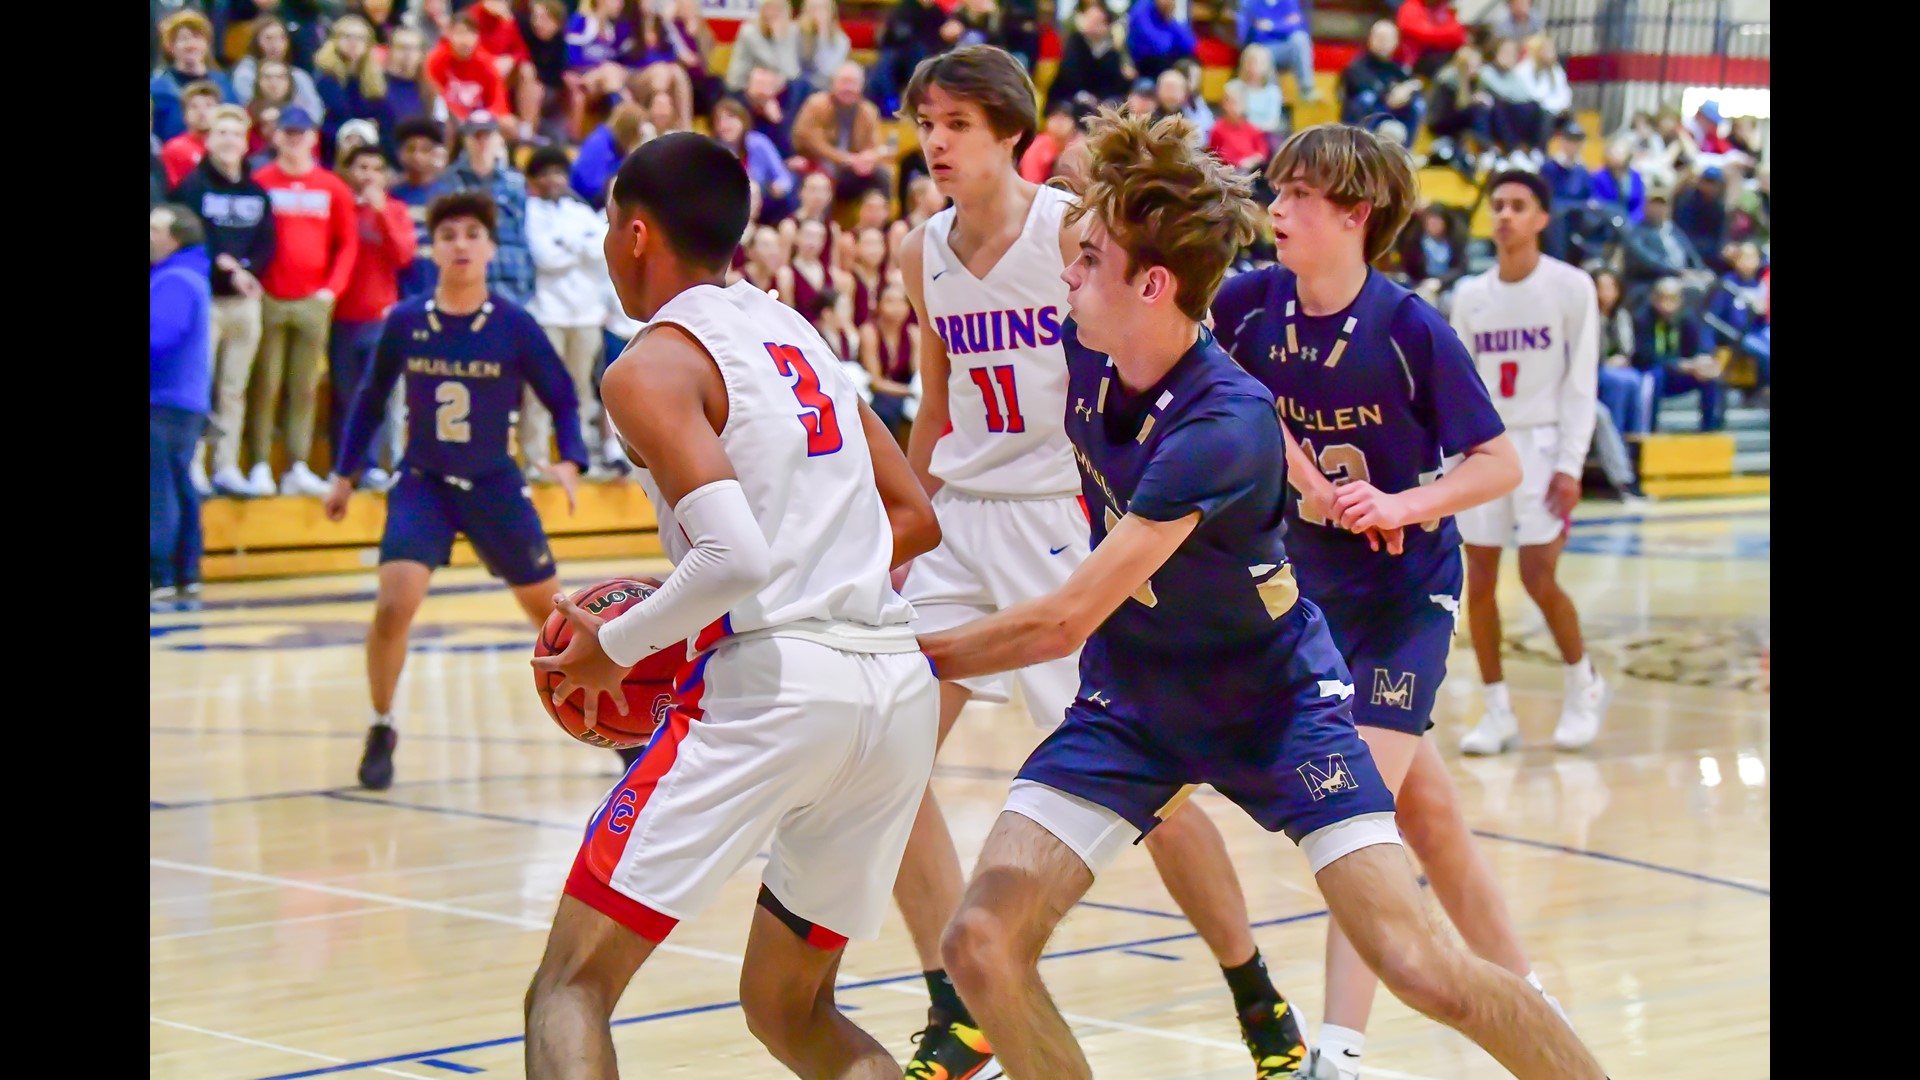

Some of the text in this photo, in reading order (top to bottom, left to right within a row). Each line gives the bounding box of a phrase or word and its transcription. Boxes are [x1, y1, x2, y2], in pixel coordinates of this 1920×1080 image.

[934, 305, 1063, 355] BRUINS
[435, 380, 471, 443] 2
[762, 341, 843, 457] 3
[968, 363, 1025, 433] 11
